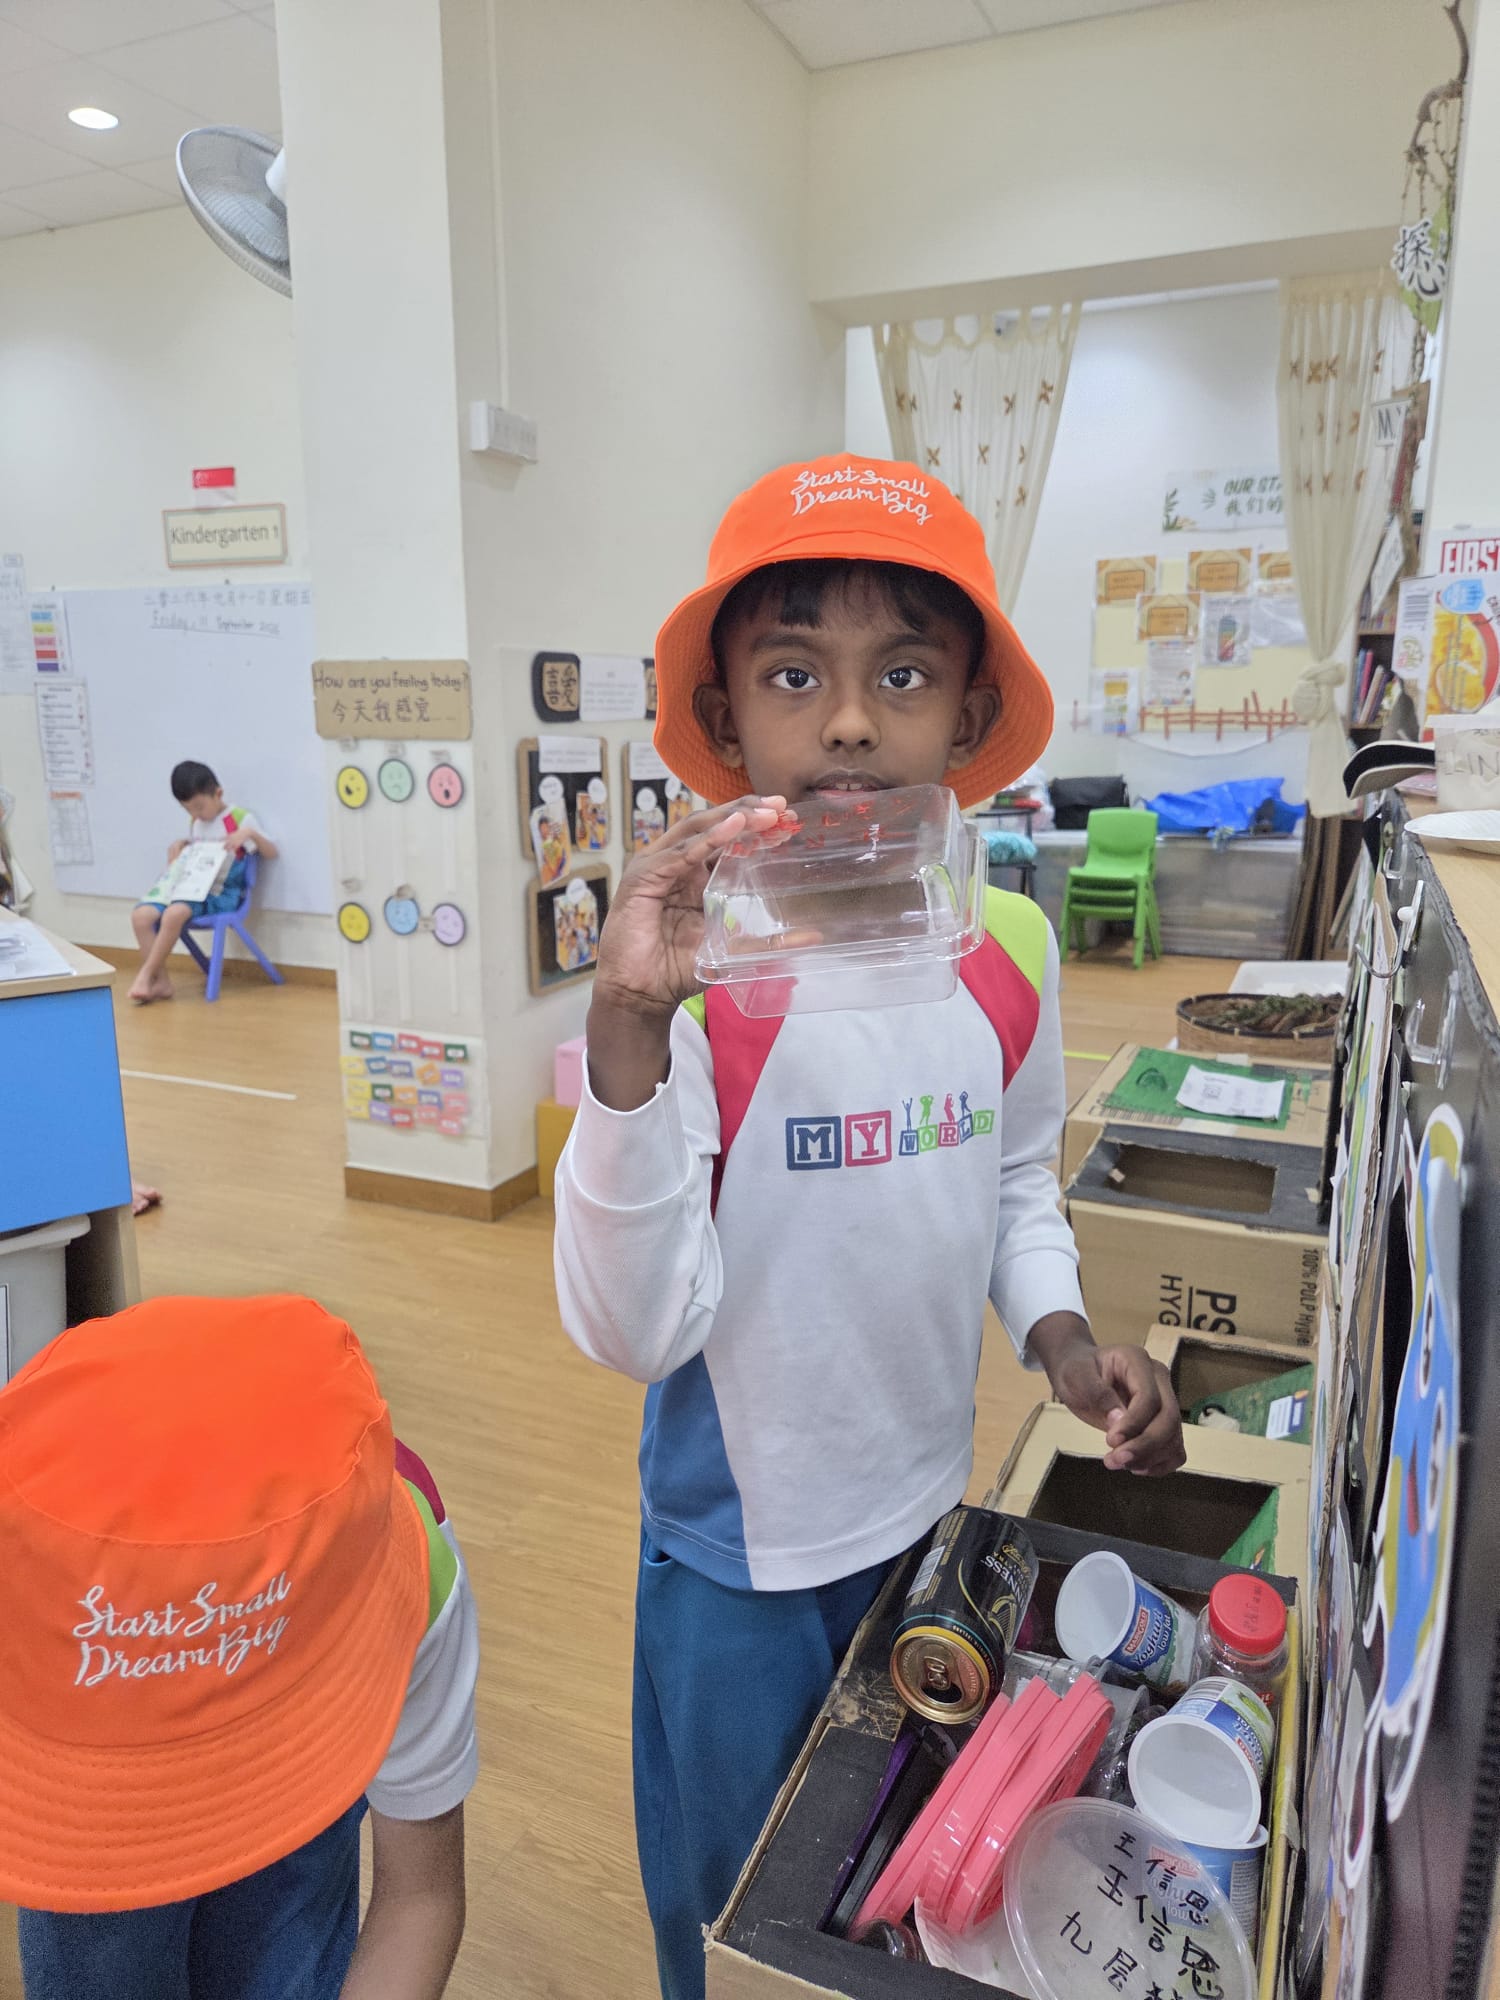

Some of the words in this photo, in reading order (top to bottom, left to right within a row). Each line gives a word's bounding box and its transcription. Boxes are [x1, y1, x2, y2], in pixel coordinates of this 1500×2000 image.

[790, 465, 860, 496] Start
[859, 469, 930, 498] Small
[1224, 477, 1255, 496] OUR
[792, 486, 881, 517] Dream
[880, 487, 933, 526] Big
[170, 524, 270, 549] Kindergarten
[313, 670, 343, 690] How
[347, 677, 367, 689] are
[369, 676, 391, 694] you
[392, 671, 430, 692] feeling
[900, 1111, 993, 1154] WORLD
[1300, 1281, 1318, 1313] PULP
[72, 1584, 186, 1638] Start
[183, 1570, 292, 1638] Small
[1125, 1608, 1149, 1654] MARIGOLD
[1134, 1607, 1164, 1666] Yoghurt
[1163, 1614, 1172, 1635] fat
[73, 1640, 215, 1688] Dream
[214, 1615, 291, 1677] Big
[1157, 1632, 1170, 1652] low
